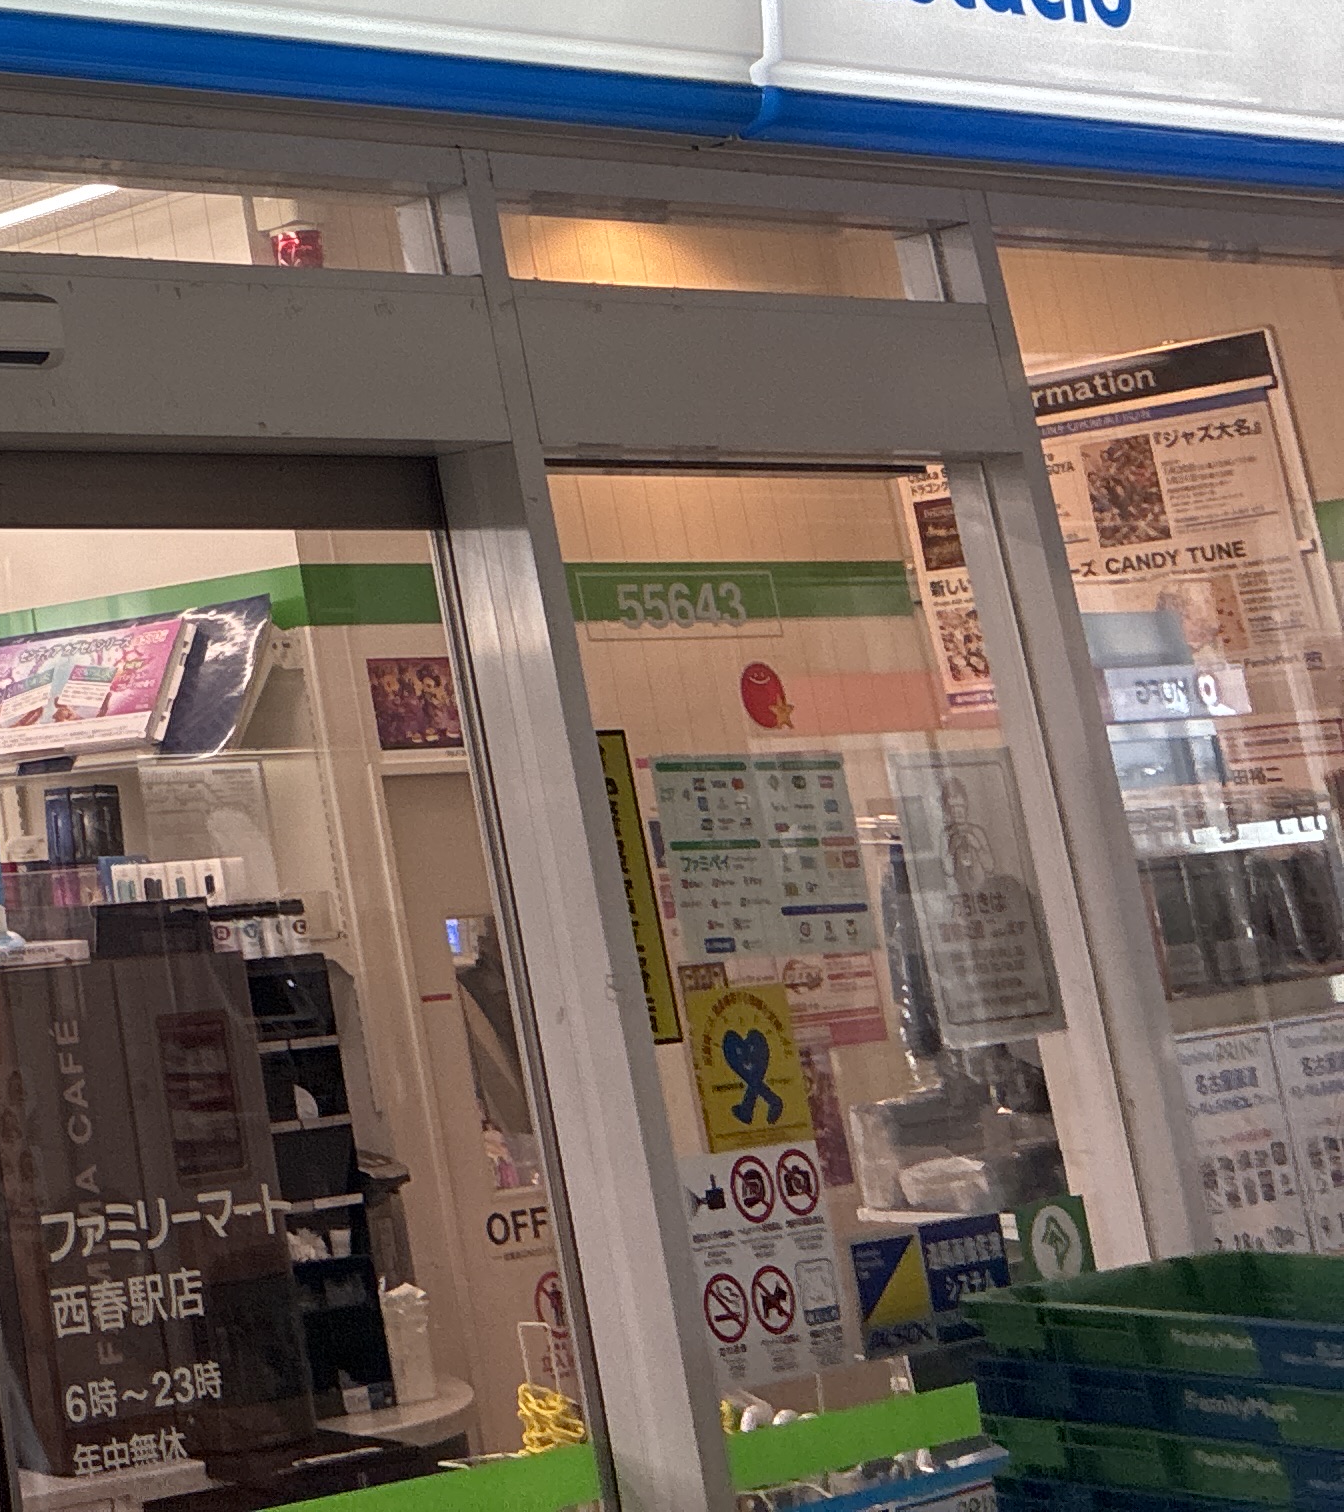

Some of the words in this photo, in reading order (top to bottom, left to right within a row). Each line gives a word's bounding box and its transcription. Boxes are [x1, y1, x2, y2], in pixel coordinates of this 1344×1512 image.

[1105, 548, 1180, 576] CANDY
[1187, 540, 1248, 565] TUNE
[615, 582, 748, 630] 55643
[40, 1183, 292, 1263] ファミリーマート
[50, 1267, 206, 1339] 西春駅店
[72, 1425, 189, 1477] 年中無休
